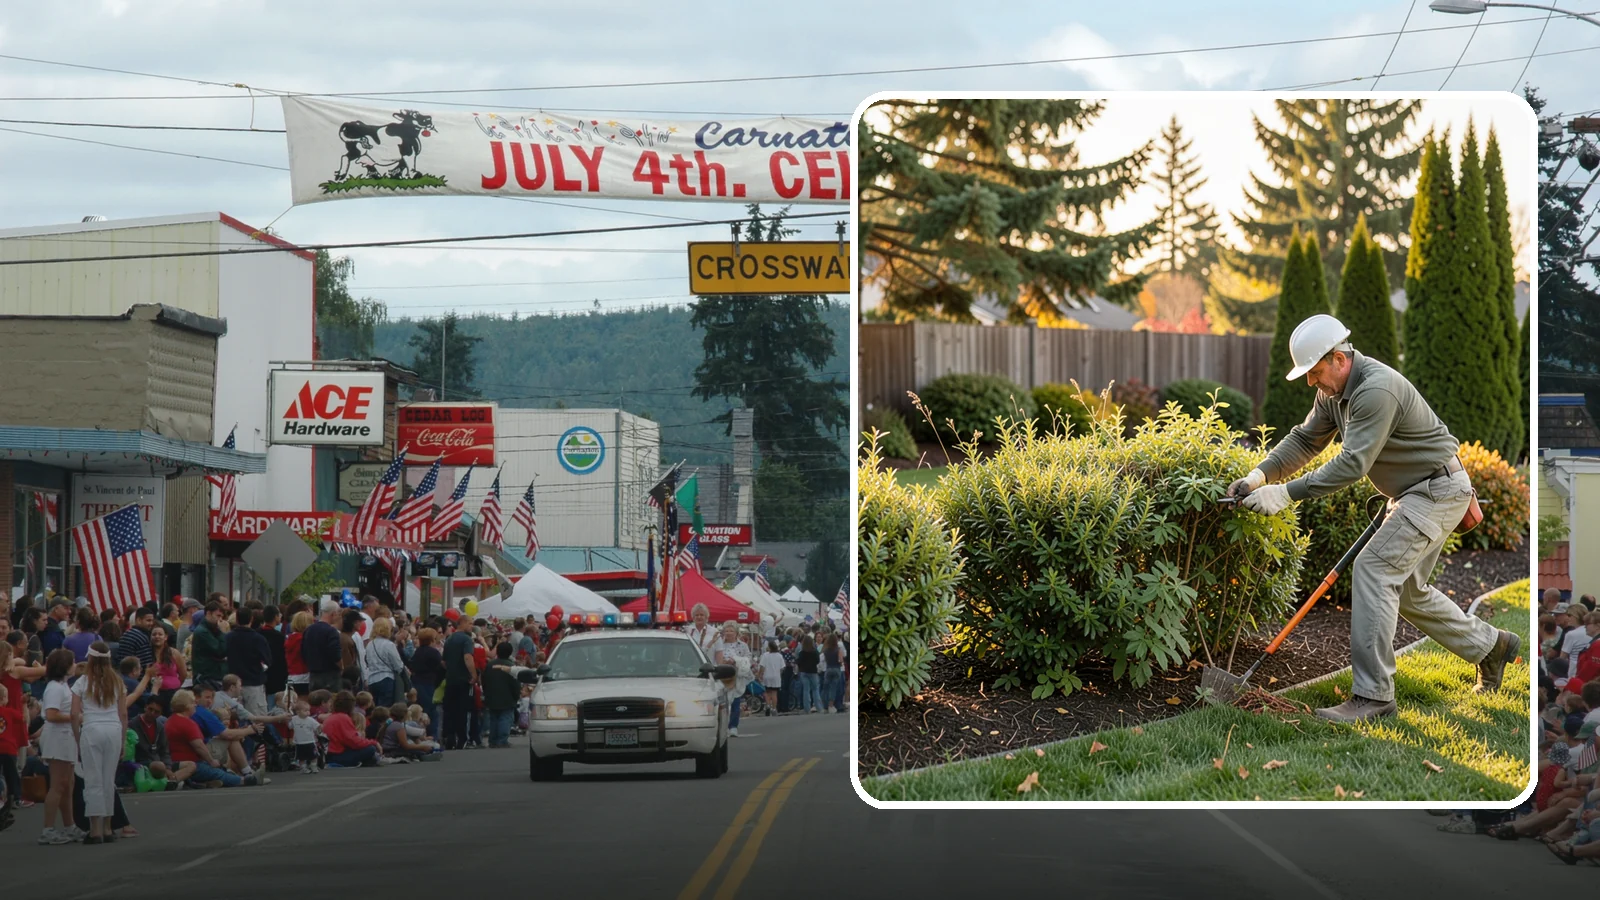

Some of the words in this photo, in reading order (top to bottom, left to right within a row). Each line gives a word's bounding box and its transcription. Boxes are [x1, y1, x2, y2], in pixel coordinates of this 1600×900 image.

[481, 141, 605, 192] JULY
[632, 150, 746, 198] 4th.
[696, 254, 850, 280] CROSSWA
[282, 380, 373, 420] ACE
[405, 409, 453, 422] CEDAR
[460, 409, 485, 422] LOG
[283, 421, 371, 437] Hardware
[416, 428, 477, 447] Coca-Cola
[354, 467, 388, 479] Simpl
[83, 484, 93, 494] St.
[95, 484, 124, 495] Vincent
[126, 486, 135, 495] de
[137, 485, 155, 495] Paul
[688, 526, 742, 535] CRNATION
[699, 535, 730, 543] GLASS
